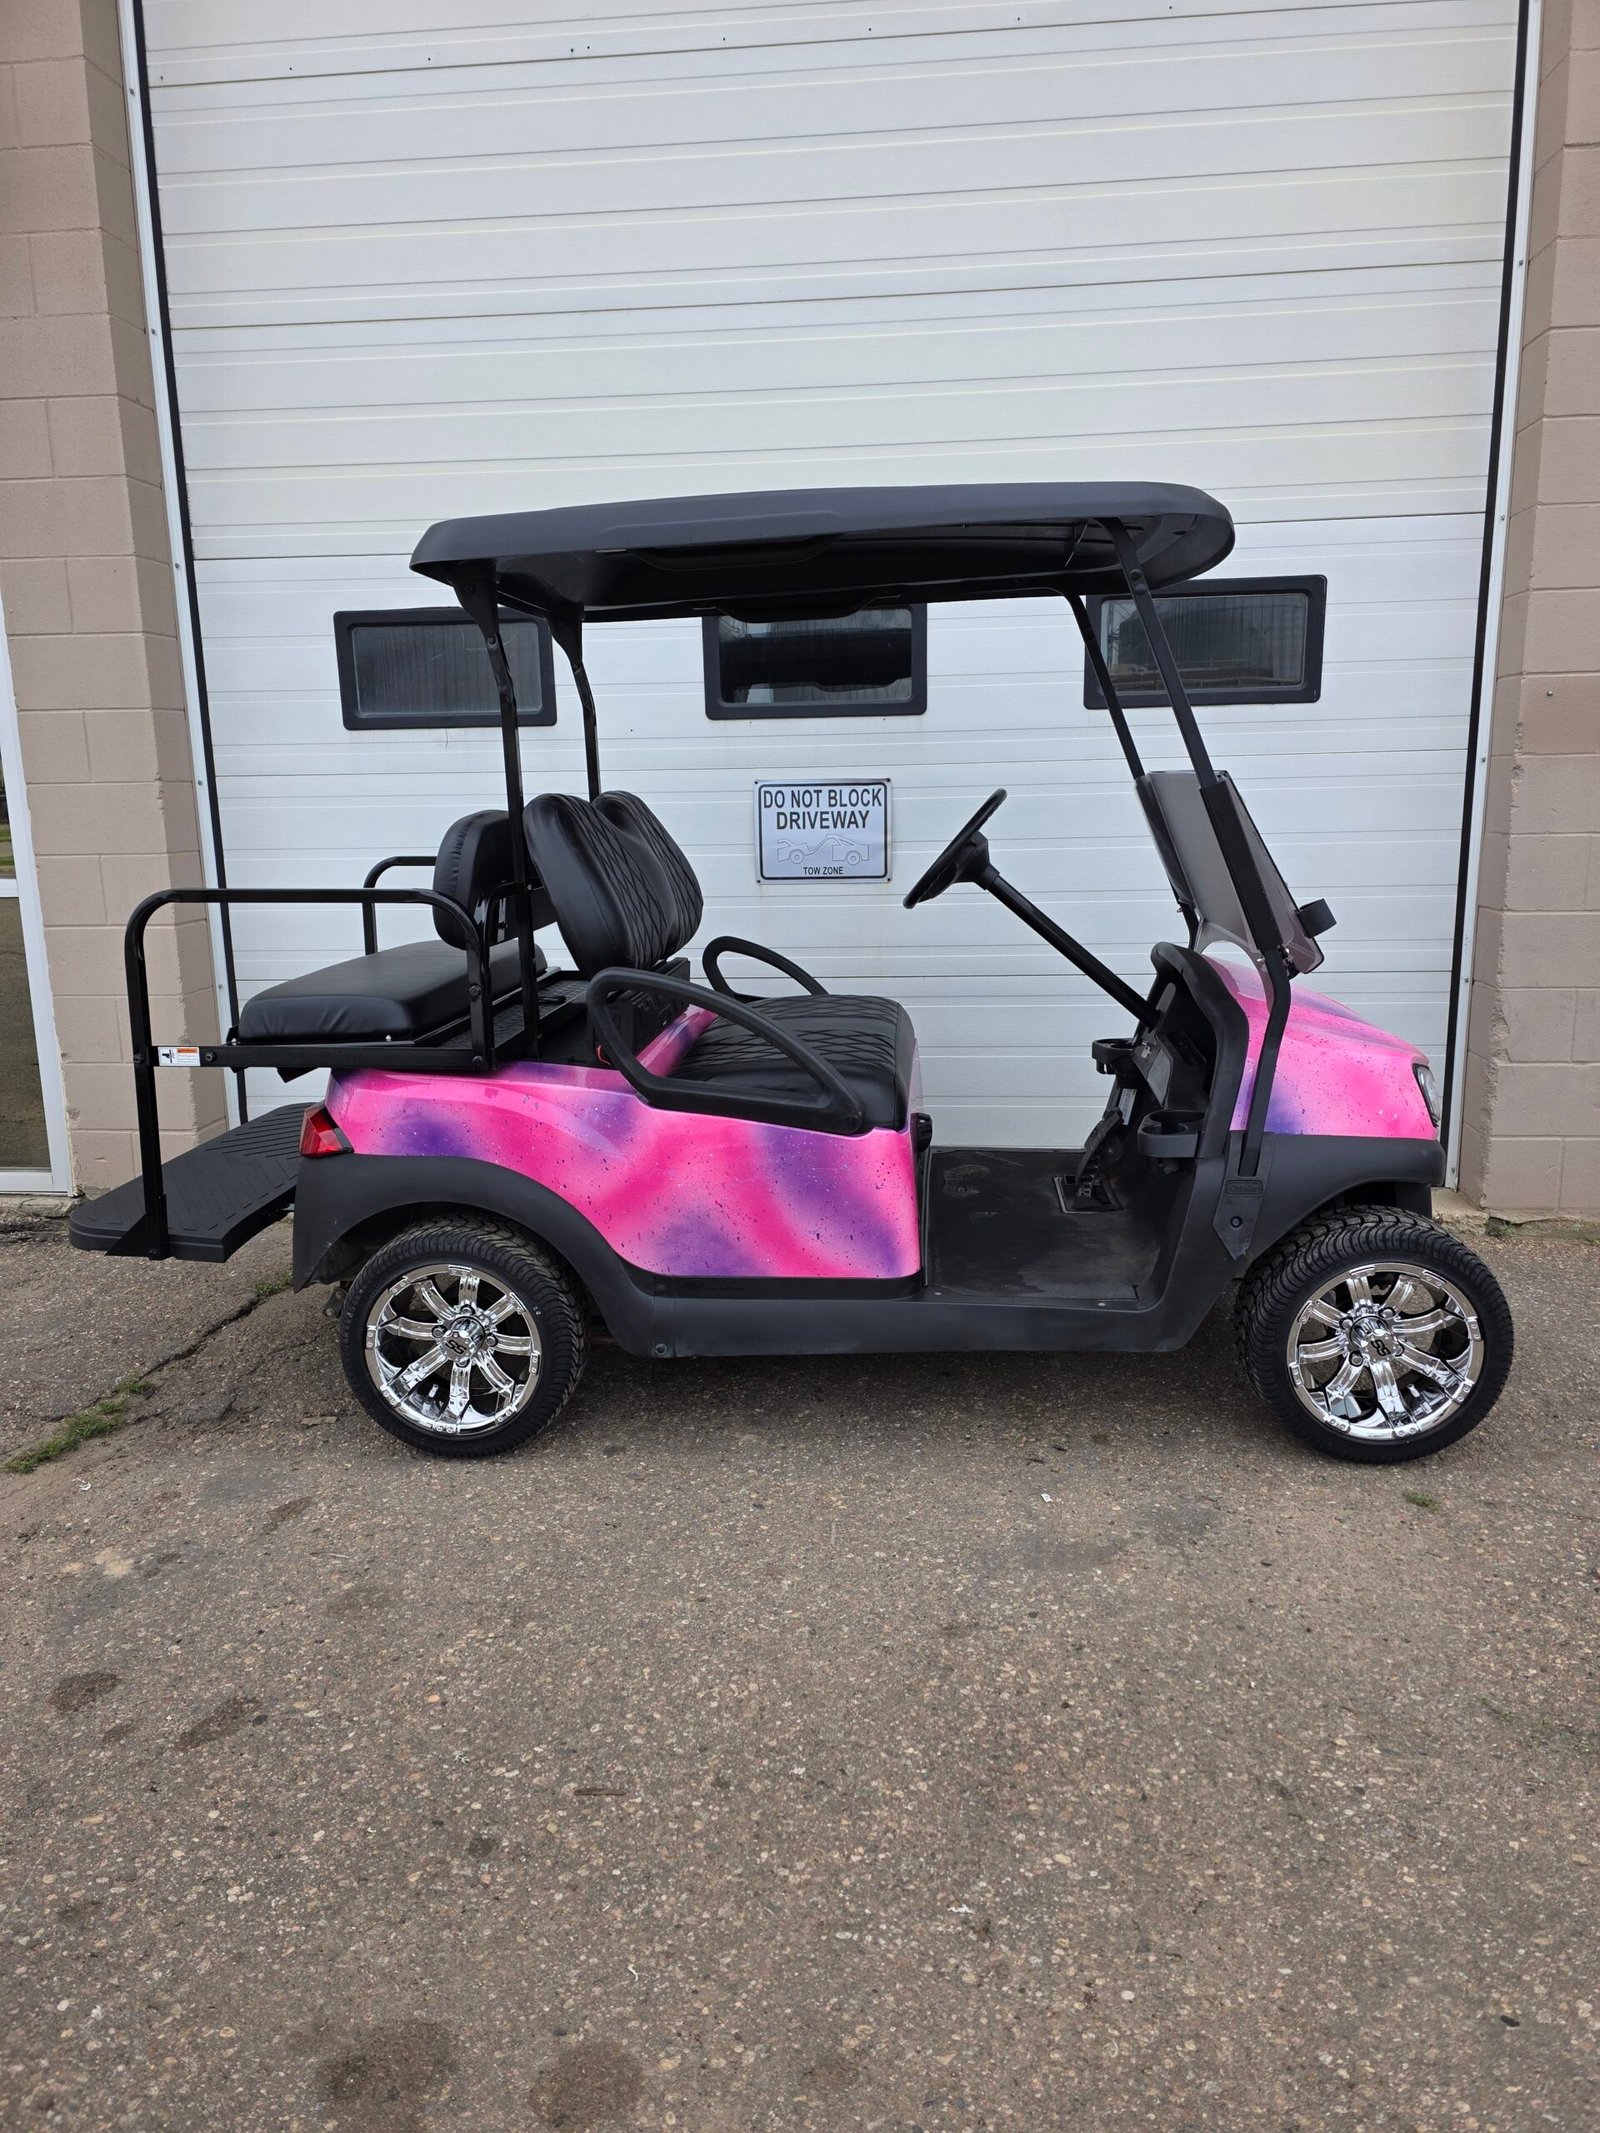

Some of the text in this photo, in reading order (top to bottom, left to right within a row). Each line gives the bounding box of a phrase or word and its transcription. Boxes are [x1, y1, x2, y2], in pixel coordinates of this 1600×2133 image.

[763, 788, 882, 808] DO NOT BLOCK
[776, 810, 869, 829] DRIVEWAY
[803, 866, 843, 875] TOW ZONE
